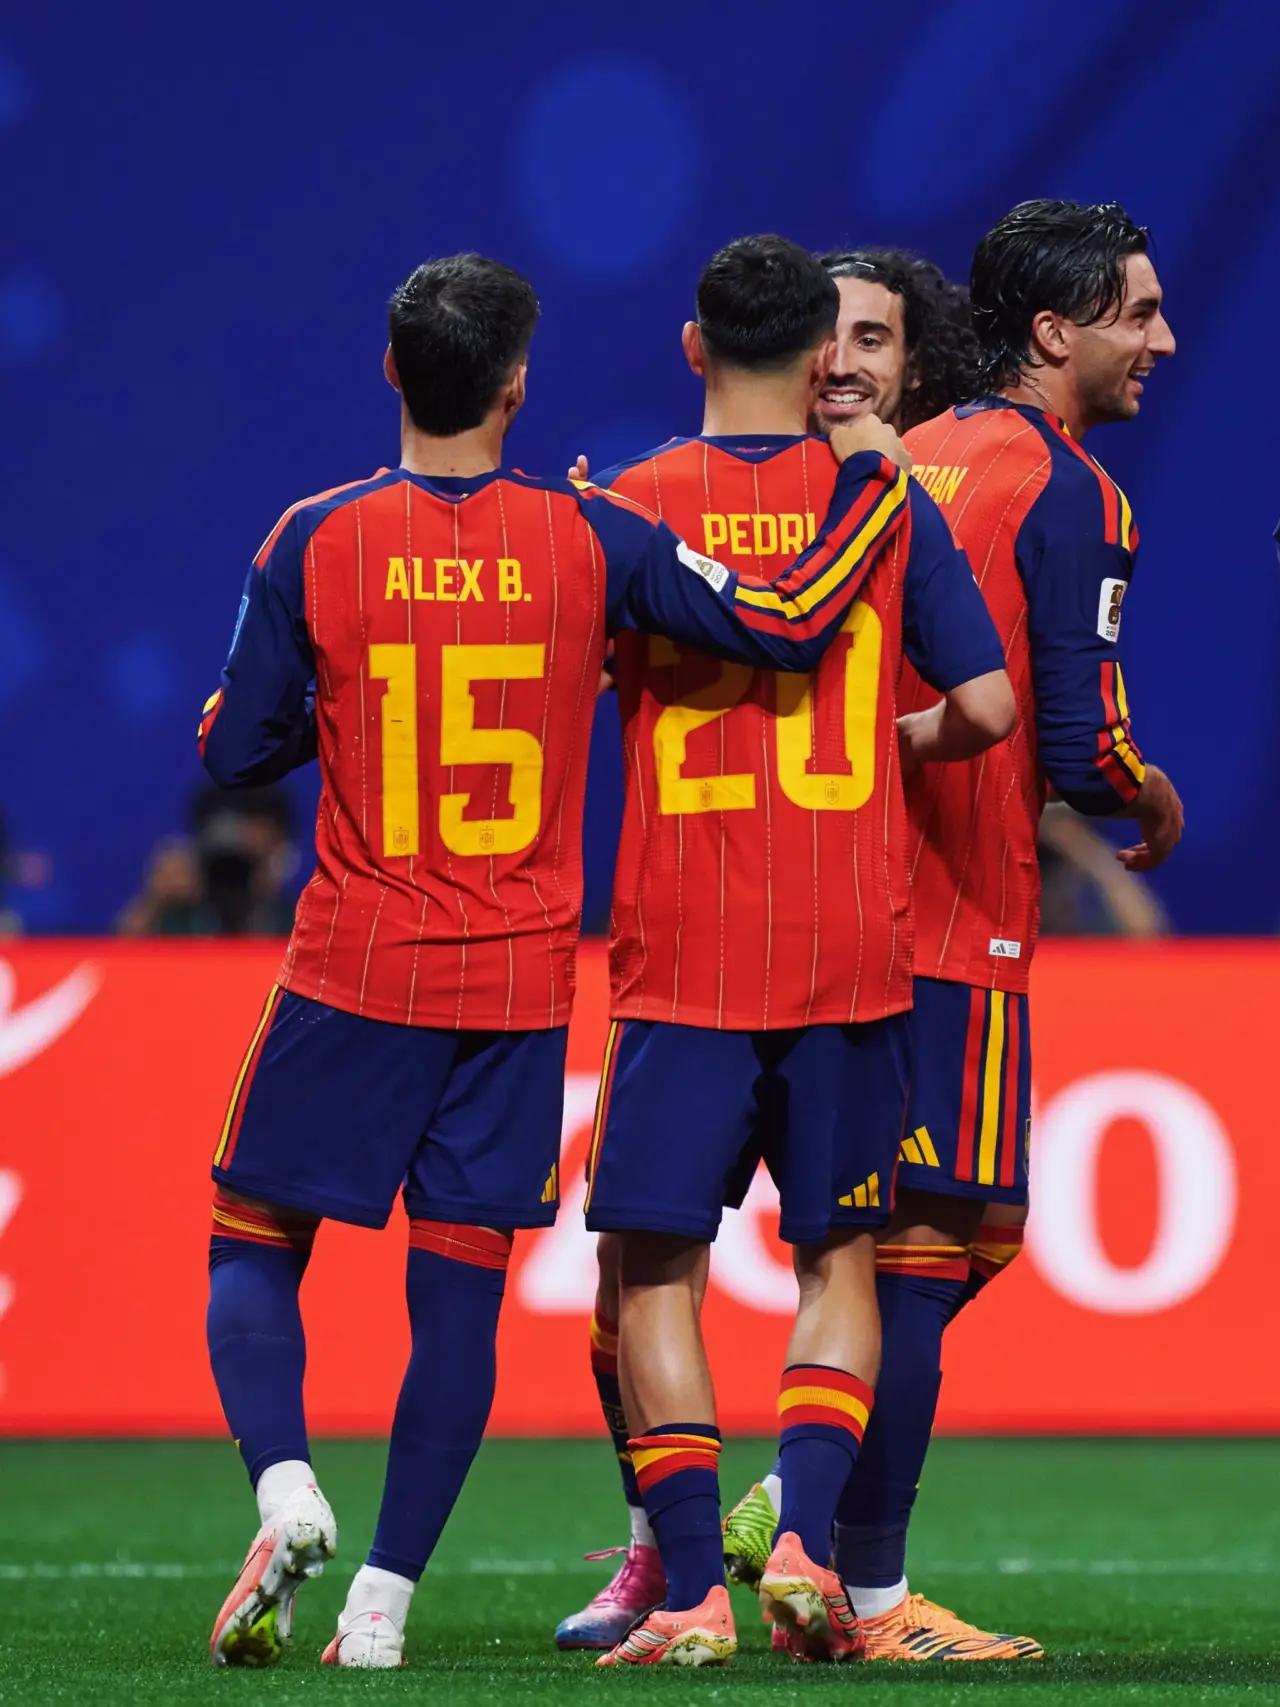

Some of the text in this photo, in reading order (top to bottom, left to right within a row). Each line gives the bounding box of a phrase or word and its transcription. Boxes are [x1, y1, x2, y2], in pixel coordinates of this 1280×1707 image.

[384, 557, 532, 602] ALEX B.
[701, 512, 816, 555] PEDRI
[368, 643, 545, 857] 15
[650, 600, 882, 815] 20
